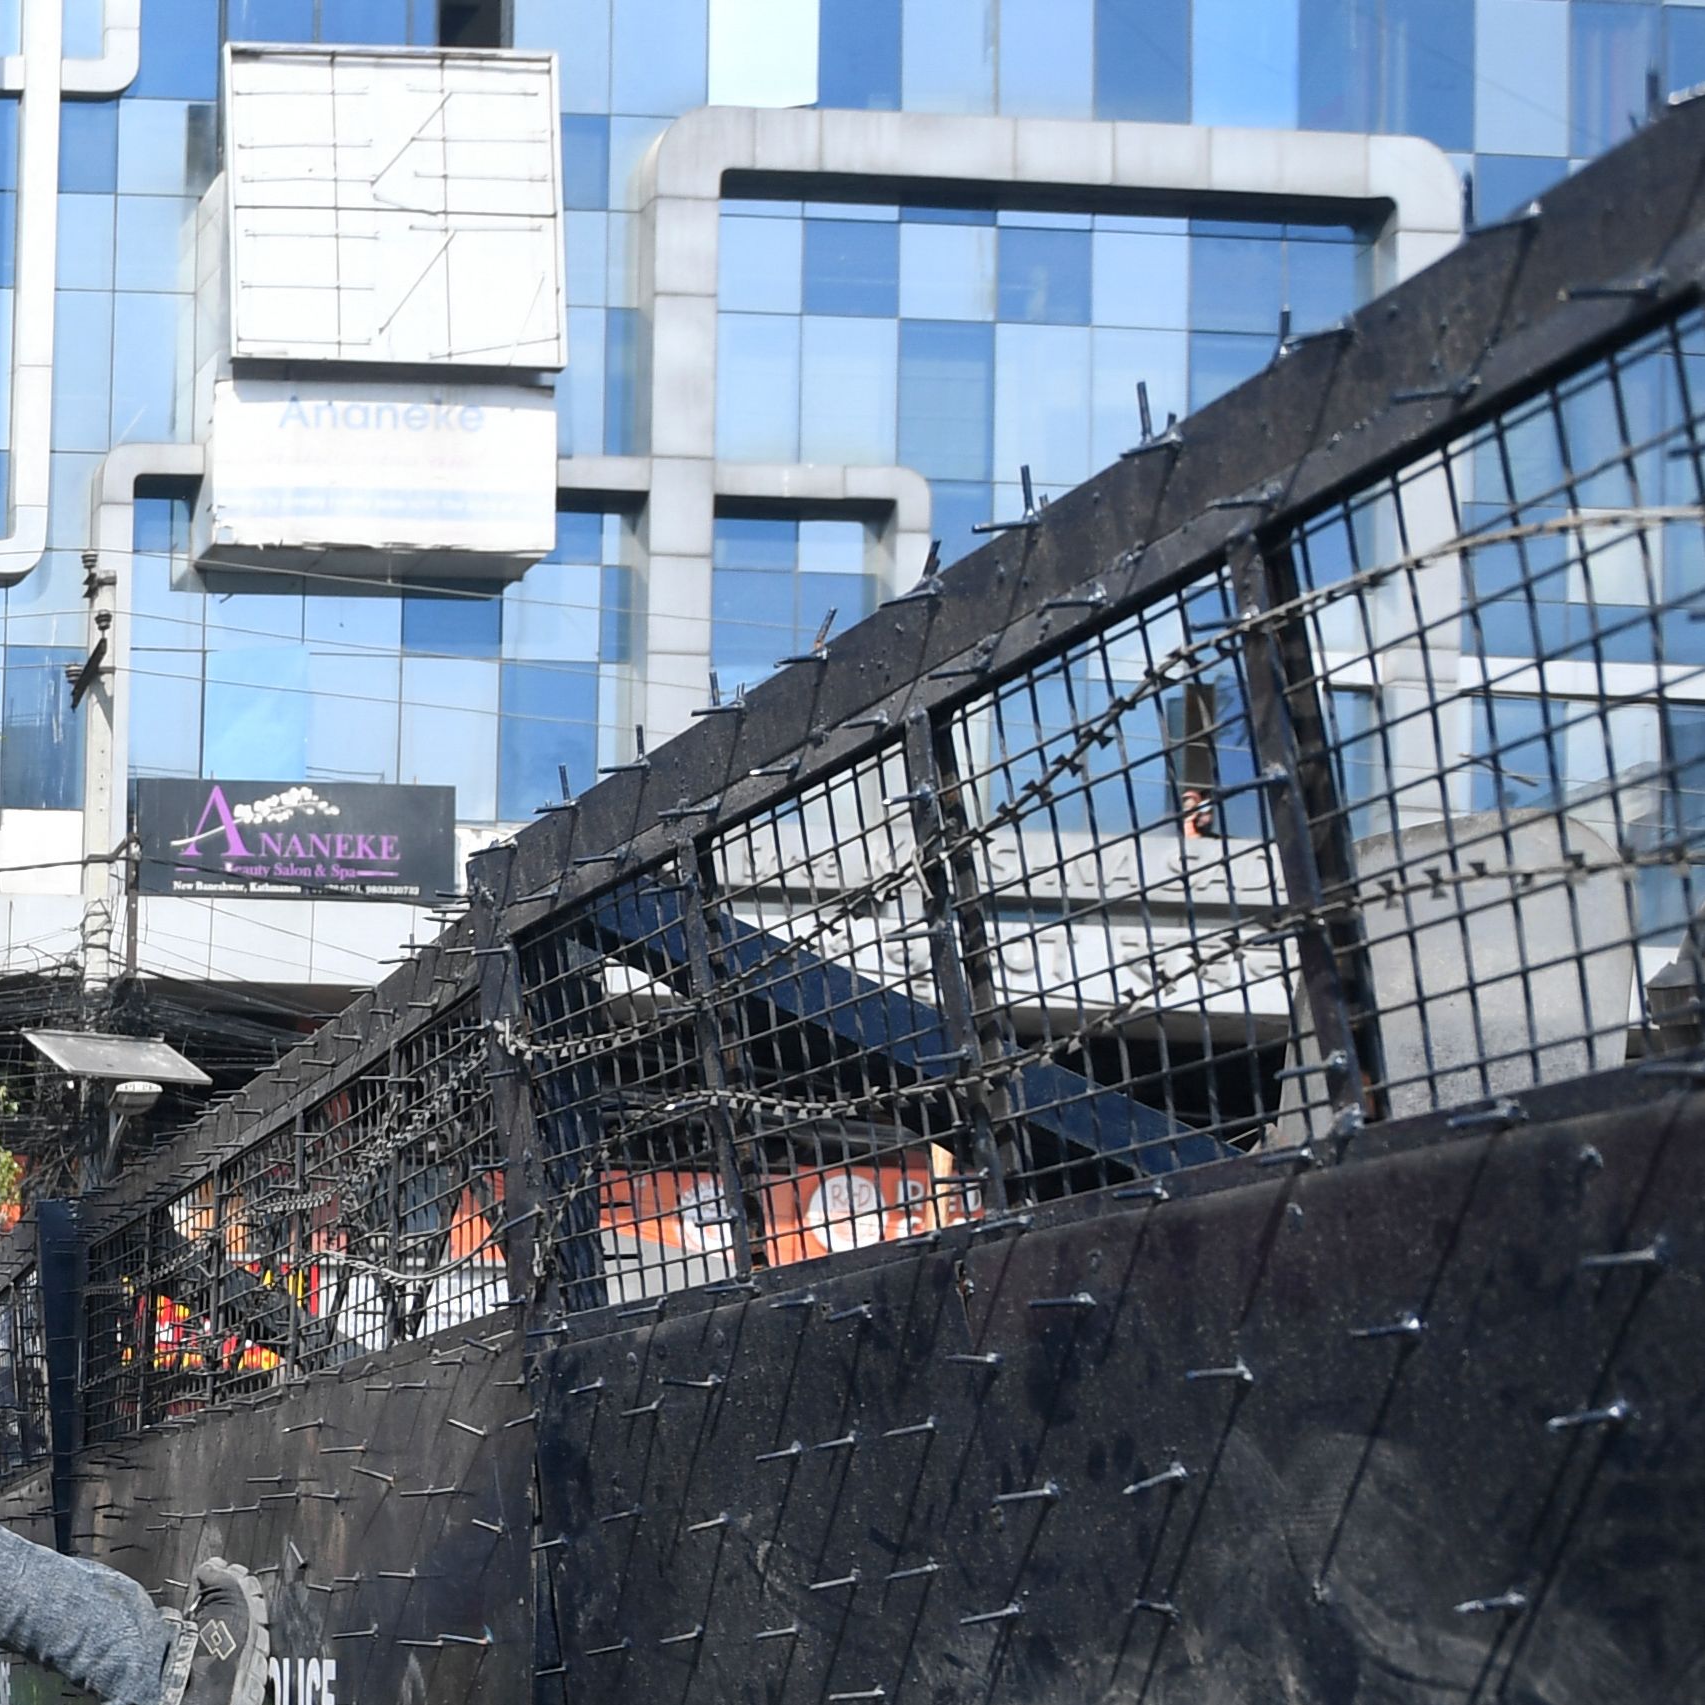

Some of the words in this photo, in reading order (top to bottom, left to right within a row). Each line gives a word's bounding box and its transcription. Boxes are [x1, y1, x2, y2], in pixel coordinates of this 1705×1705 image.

[278, 396, 484, 433] Ananeke
[180, 784, 402, 861] ANANEKE
[173, 880, 194, 891] New
[273, 862, 312, 878] Salon
[314, 863, 327, 878] &
[331, 863, 356, 881] Spa
